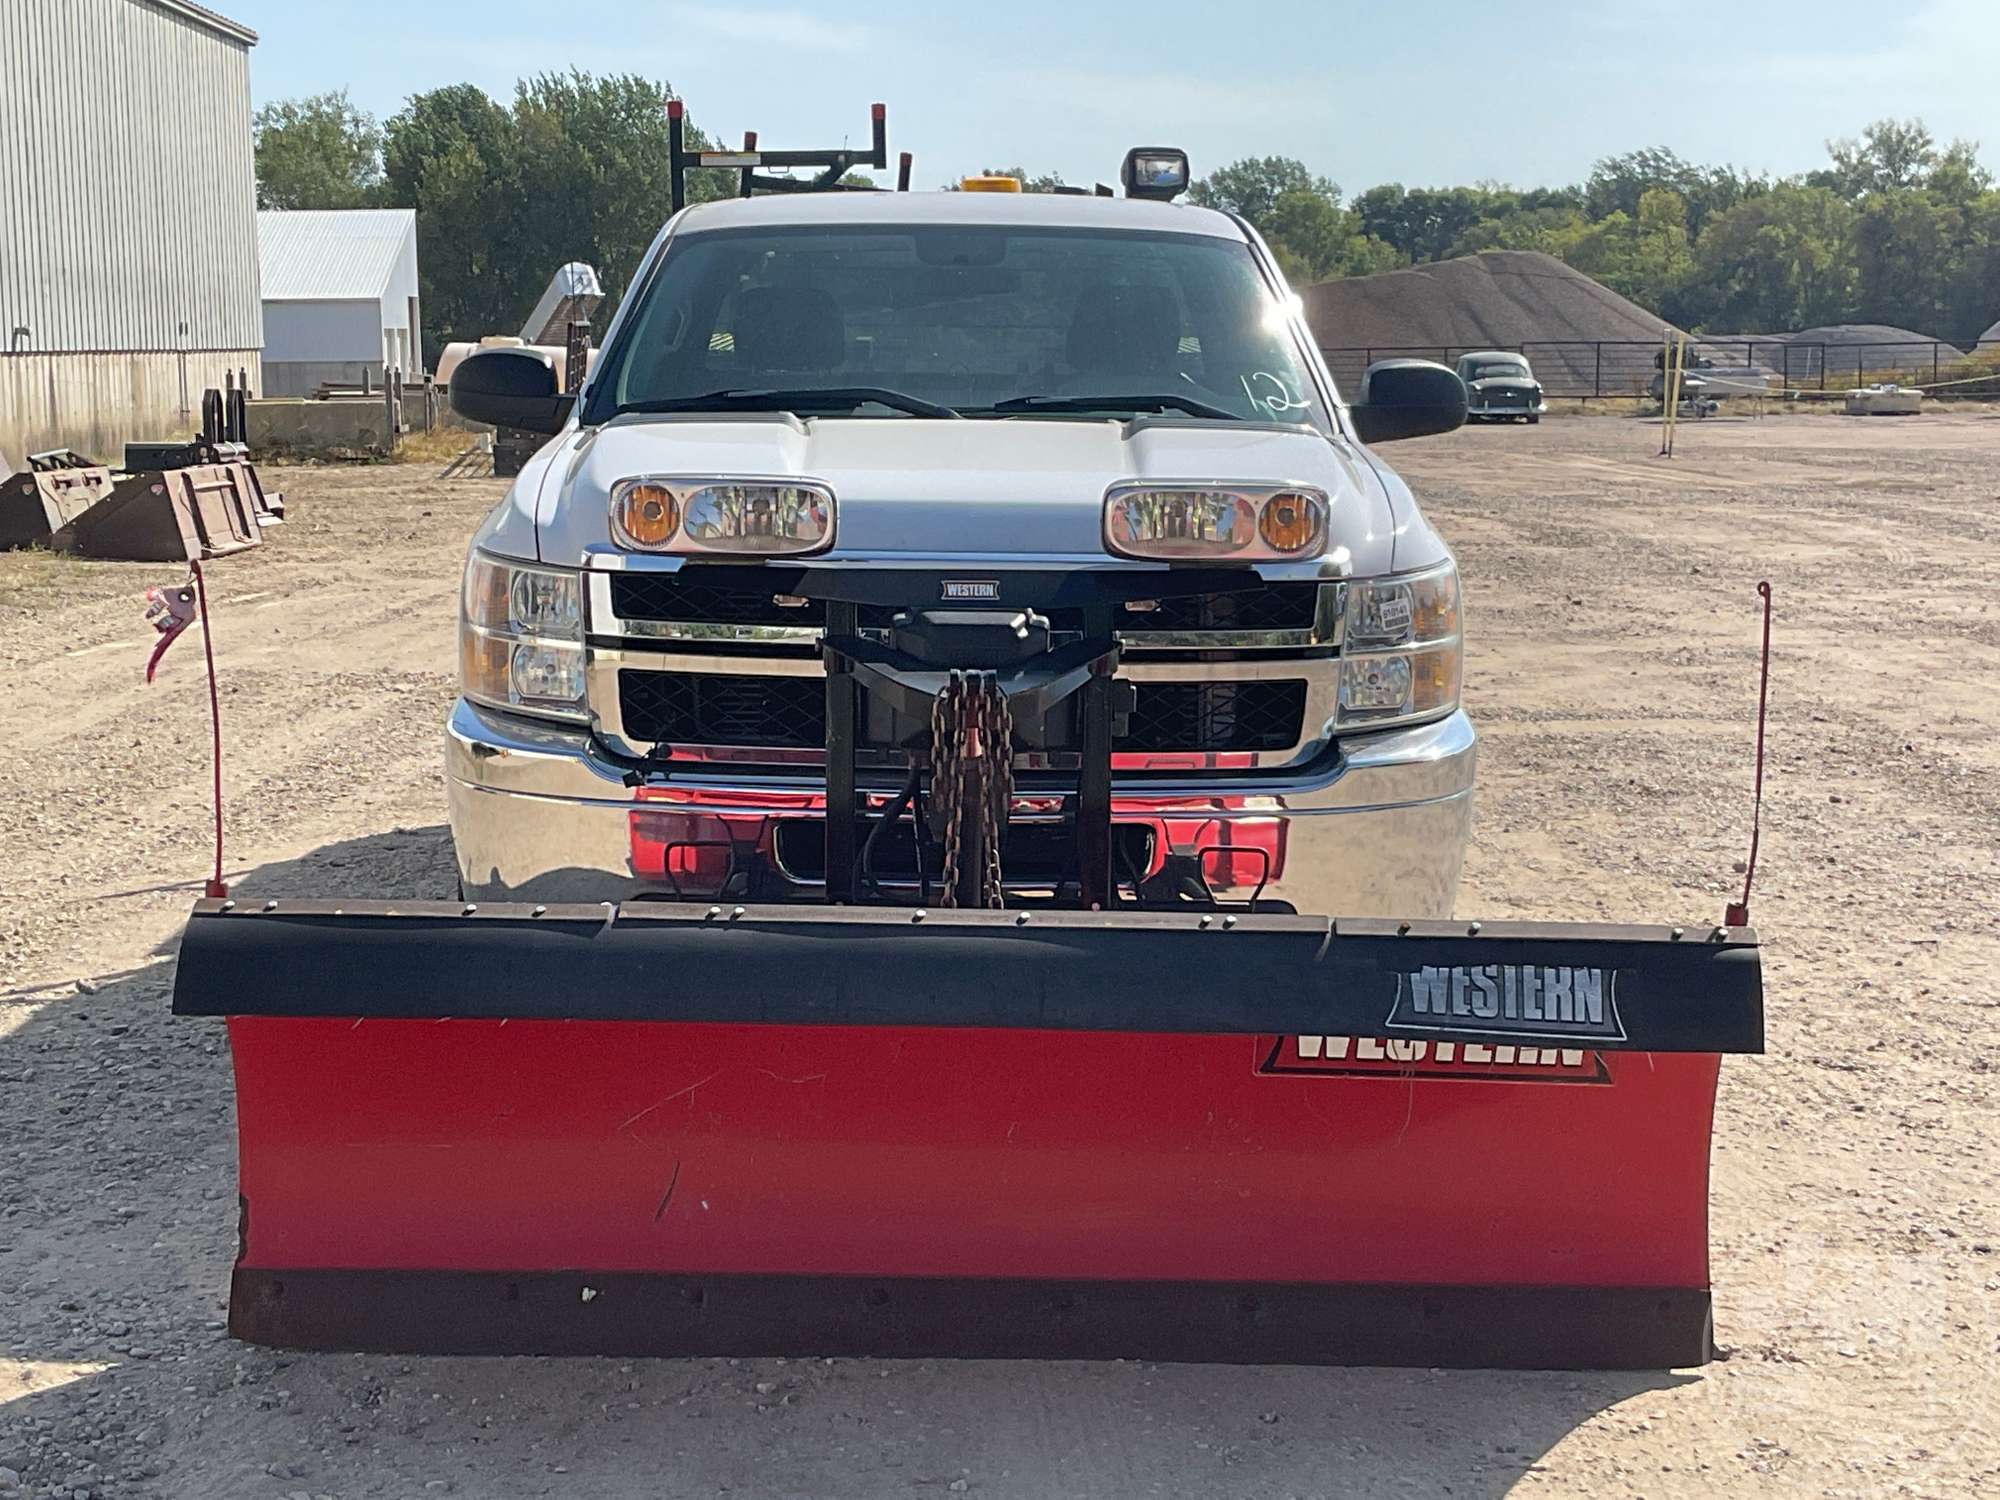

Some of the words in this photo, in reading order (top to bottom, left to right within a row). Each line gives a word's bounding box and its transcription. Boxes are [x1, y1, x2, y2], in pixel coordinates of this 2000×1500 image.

[1240, 371, 1311, 412] 12
[946, 583, 994, 597] WESTERN
[1410, 965, 1603, 1024] WESTERN
